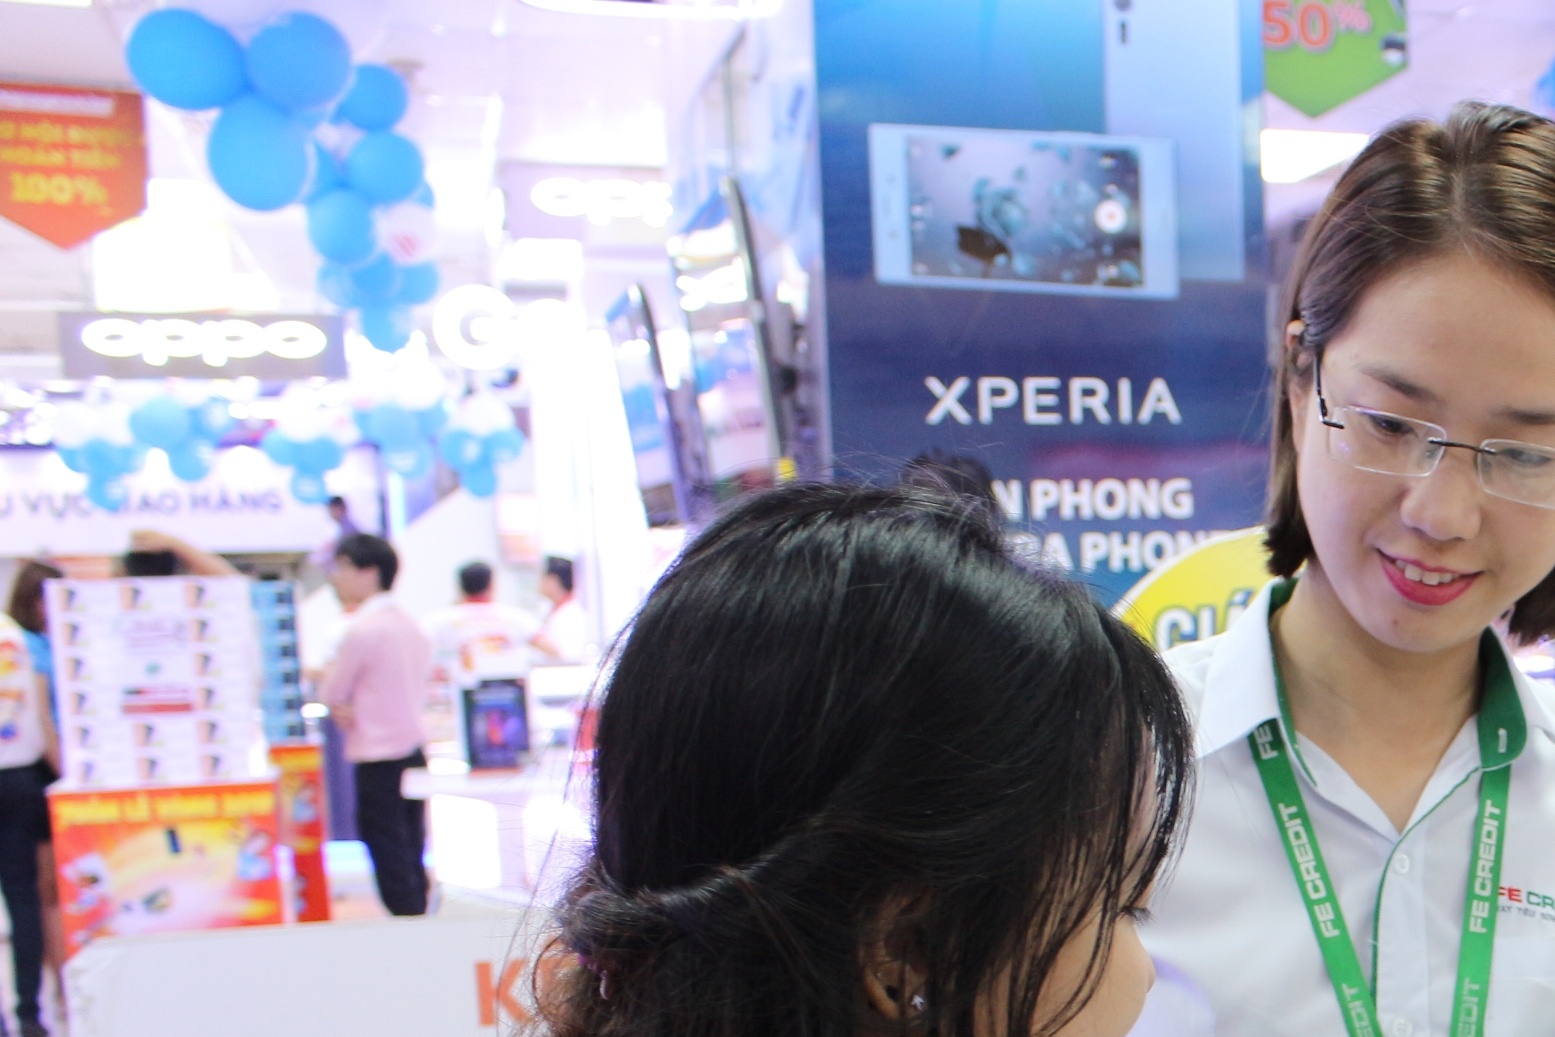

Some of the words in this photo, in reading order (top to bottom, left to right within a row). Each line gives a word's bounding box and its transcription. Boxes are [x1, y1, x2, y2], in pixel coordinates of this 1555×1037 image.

[924, 376, 1182, 426] XPERIA
[1029, 477, 1195, 522] PHONG
[1278, 803, 1331, 902] CREDIT
[1471, 799, 1502, 897] CREDIT
[1318, 906, 1341, 938] FE
[1468, 899, 1488, 934] FE
[474, 960, 535, 1028] K
